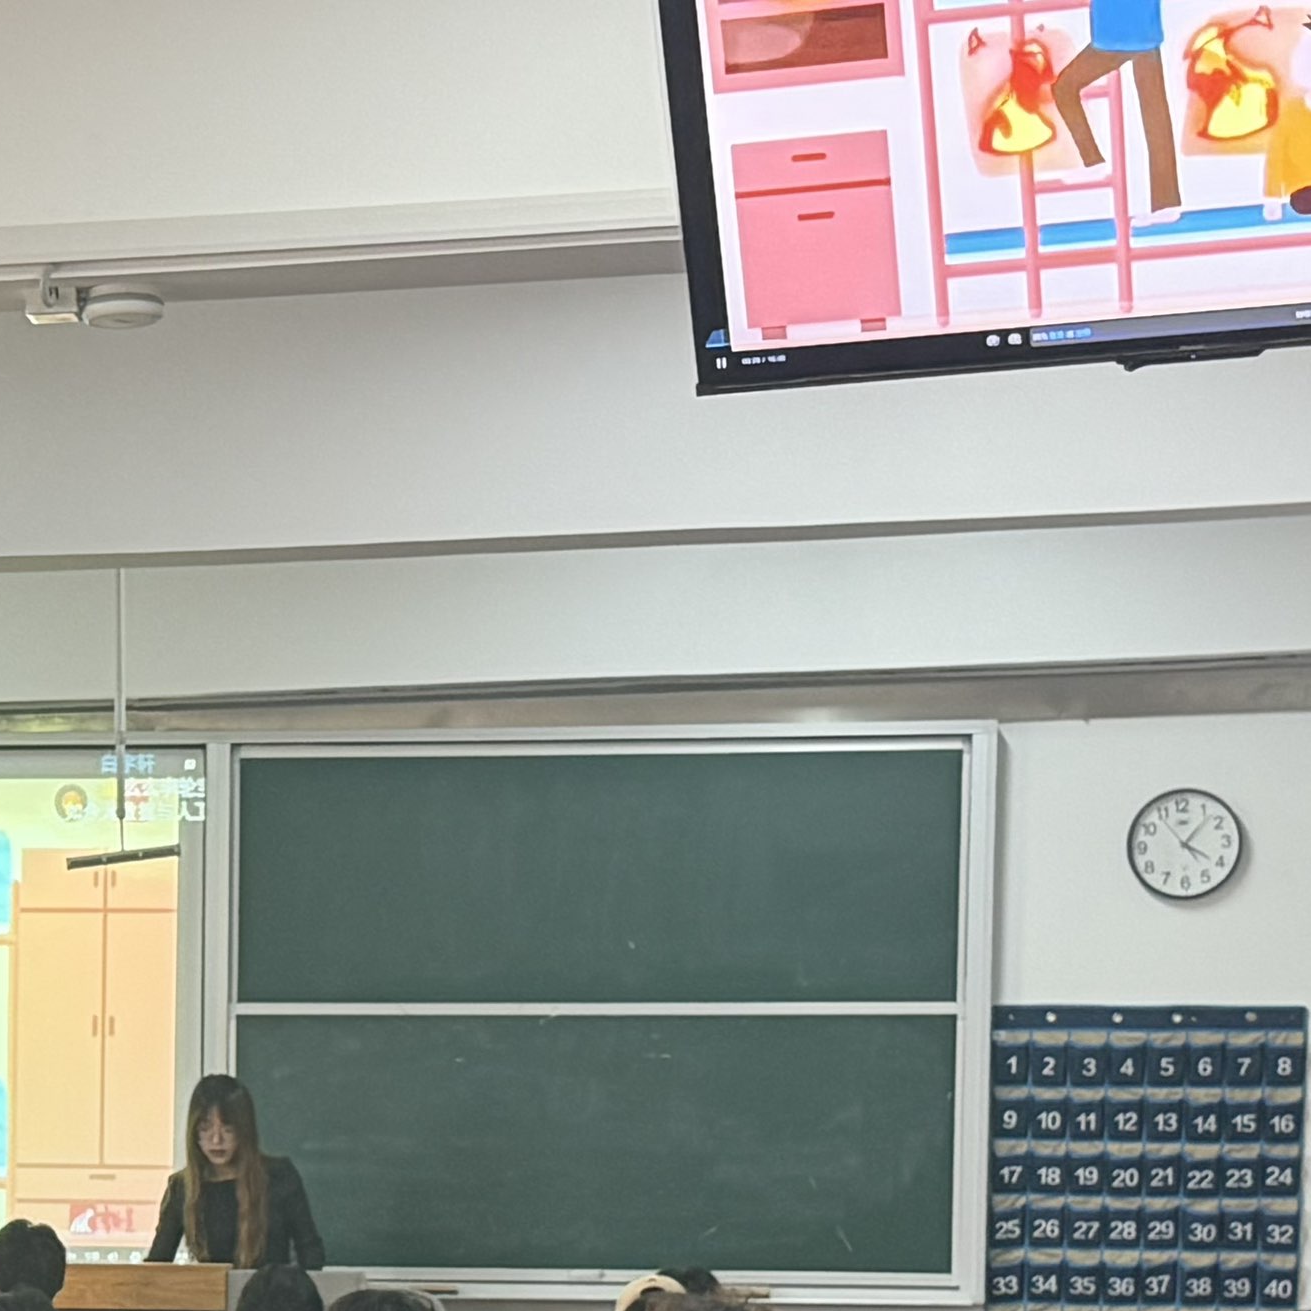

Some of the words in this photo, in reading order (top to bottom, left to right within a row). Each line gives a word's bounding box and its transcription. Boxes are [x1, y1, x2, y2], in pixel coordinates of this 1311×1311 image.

[1157, 806, 1169, 820] 11
[1175, 798, 1189, 813] 12
[1201, 803, 1206, 815] 1
[1142, 821, 1157, 836] 10
[1214, 815, 1224, 830] 2
[1137, 840, 1147, 855] 9
[1221, 834, 1231, 848] 3
[1144, 860, 1154, 874] 8
[1215, 855, 1225, 868] 4
[1162, 871, 1171, 885] 7
[1007, 1055, 1018, 1074] 1
[1041, 1056, 1056, 1076] 2
[1082, 1057, 1097, 1077] 3
[1119, 1057, 1134, 1076] 4
[1160, 1057, 1175, 1077] 5
[1197, 1056, 1213, 1077] 6
[1237, 1057, 1252, 1076] 7
[1276, 1056, 1292, 1076] 8
[1003, 1110, 1018, 1129] 9
[1037, 1110, 1062, 1130] 10
[1076, 1112, 1096, 1131] 11
[1114, 1111, 1138, 1131] 12
[1154, 1112, 1178, 1132] 13
[1193, 1114, 1217, 1134] 14
[1231, 1113, 1256, 1133] 15
[1269, 1114, 1295, 1133] 16
[999, 1165, 1023, 1184] 17
[1037, 1166, 1061, 1186] 18
[1074, 1166, 1099, 1186] 19
[1111, 1167, 1139, 1188] 20
[1150, 1166, 1174, 1187] 21
[1186, 1169, 1215, 1189] 22
[1225, 1168, 1253, 1188] 23
[1265, 1165, 1293, 1186] 24
[995, 1218, 1021, 1239] 25
[1032, 1218, 1060, 1238] 26
[1073, 1220, 1100, 1240] 27
[1109, 1220, 1137, 1240] 28
[1147, 1220, 1175, 1240] 29
[1188, 1222, 1217, 1242] 30
[1228, 1221, 1253, 1241] 31
[1266, 1224, 1294, 1244] 32
[993, 1275, 1019, 1295] 33
[1031, 1274, 1058, 1294] 34
[1069, 1275, 1096, 1295] 35
[1107, 1276, 1135, 1296] 36
[1145, 1274, 1171, 1296] 37
[1185, 1277, 1212, 1297] 38
[1223, 1277, 1251, 1298] 39
[1263, 1279, 1293, 1299] 40
